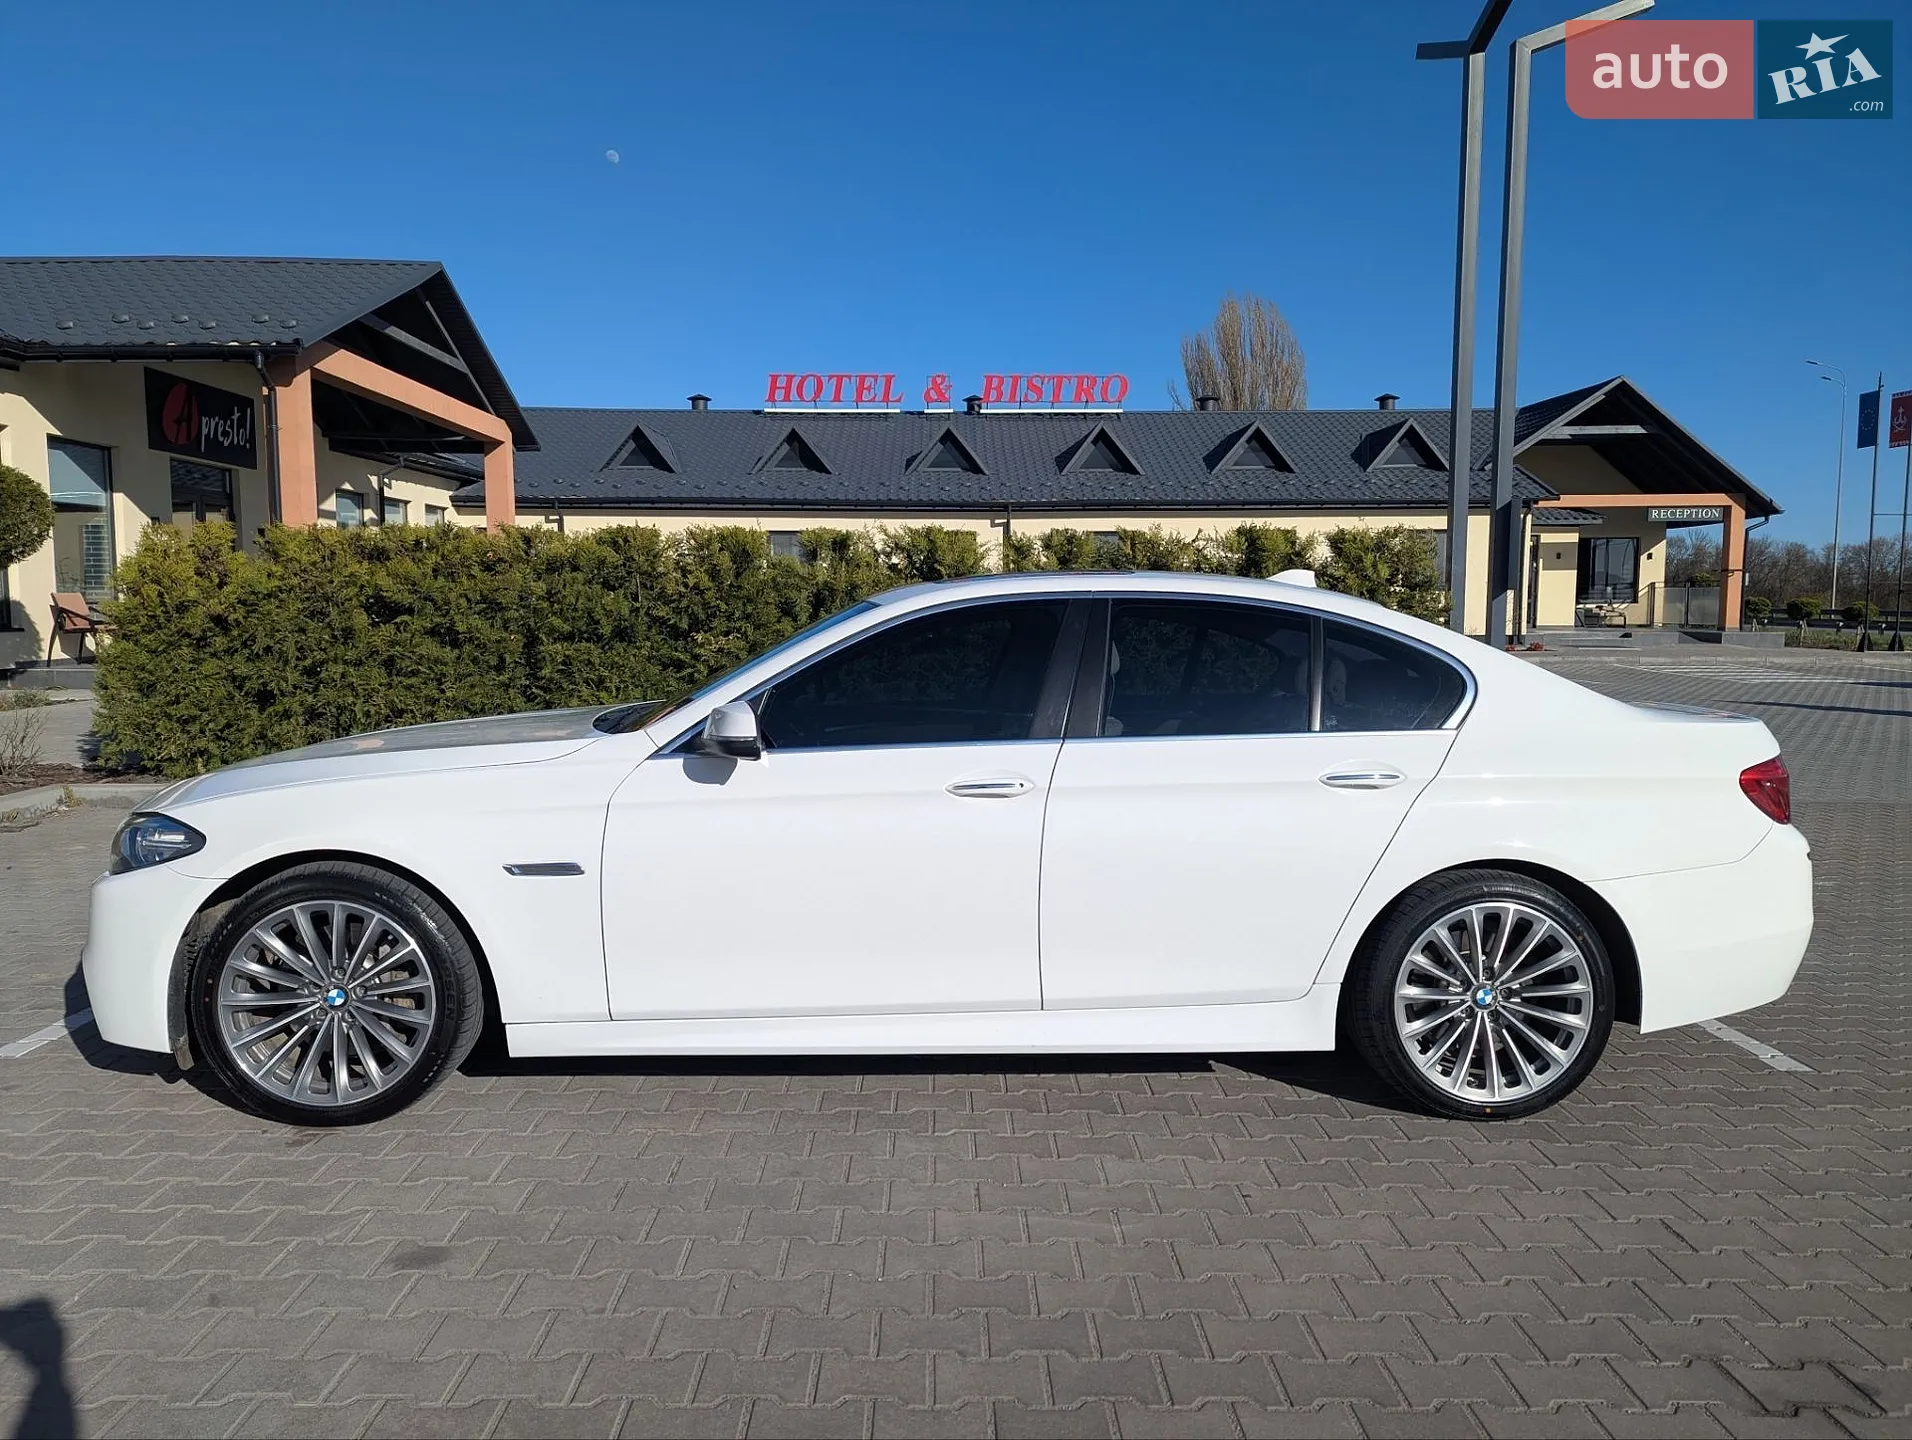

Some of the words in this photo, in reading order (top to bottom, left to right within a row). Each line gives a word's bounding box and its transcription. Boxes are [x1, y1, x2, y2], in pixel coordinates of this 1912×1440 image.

[765, 373, 903, 404] HOTEL
[924, 373, 953, 404] &
[980, 373, 1130, 404] BISTRO
[1651, 508, 1720, 519] RECEPTION
